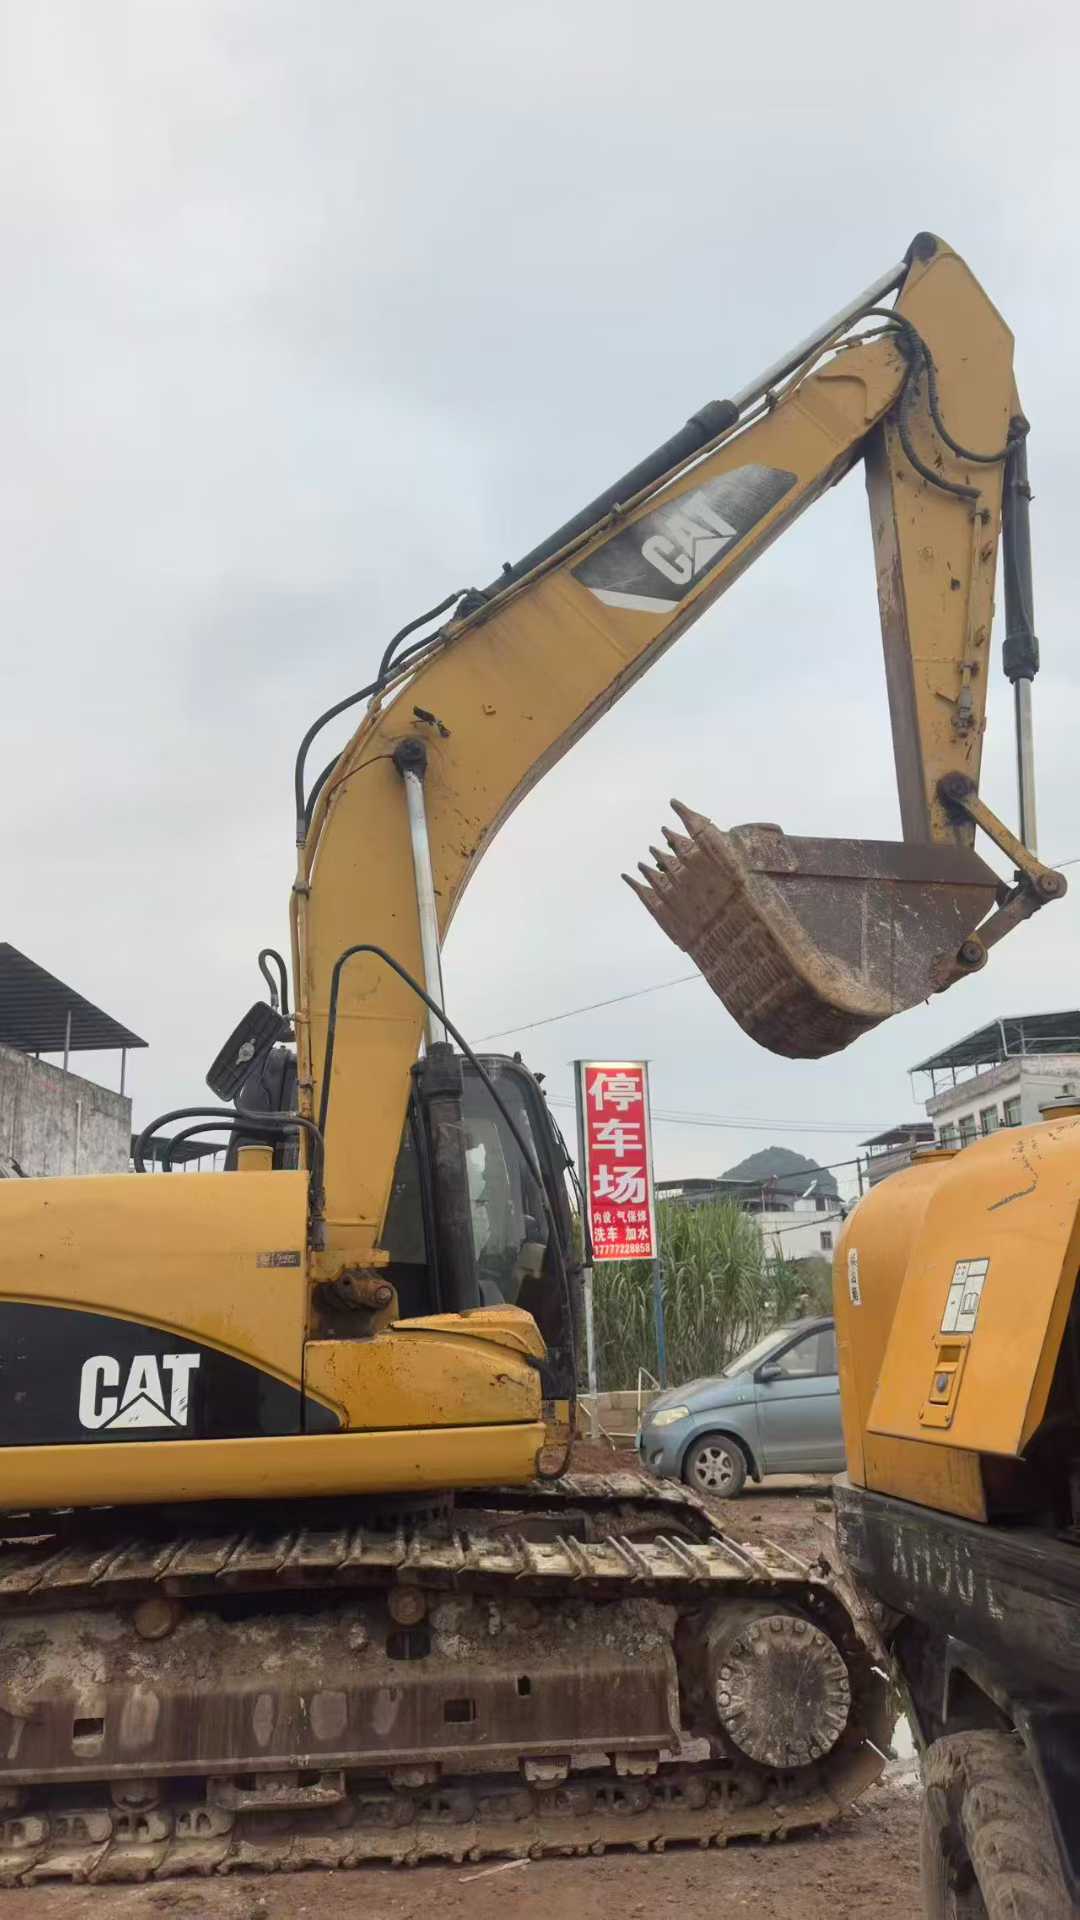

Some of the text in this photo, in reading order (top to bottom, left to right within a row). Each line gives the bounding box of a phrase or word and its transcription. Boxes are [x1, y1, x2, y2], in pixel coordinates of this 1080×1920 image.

[641, 489, 737, 584] CAT
[588, 1072, 646, 1204] 停车场
[594, 1225, 649, 1242] 洗车 加水
[78, 1353, 200, 1430] CAT
